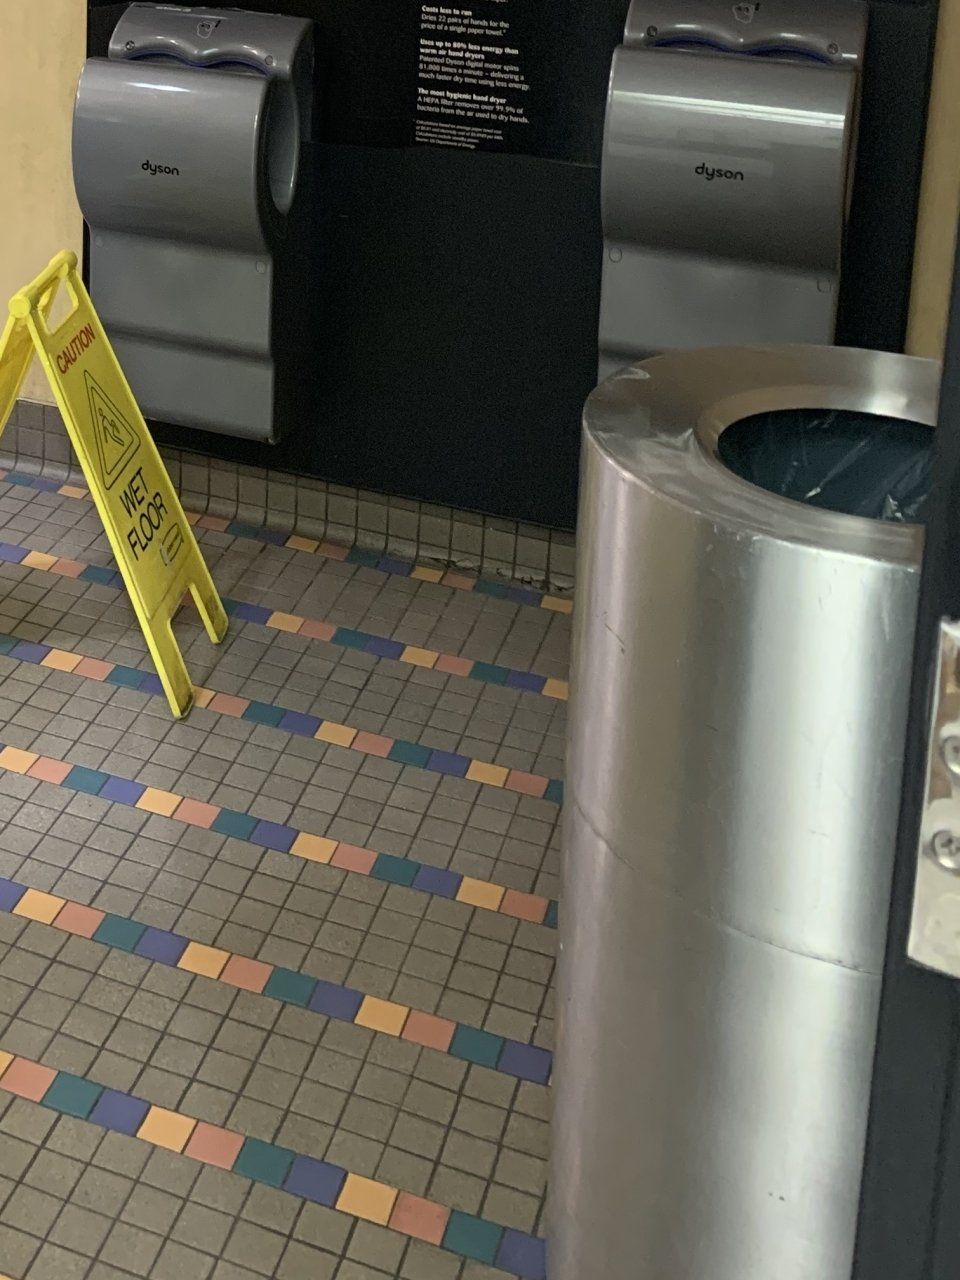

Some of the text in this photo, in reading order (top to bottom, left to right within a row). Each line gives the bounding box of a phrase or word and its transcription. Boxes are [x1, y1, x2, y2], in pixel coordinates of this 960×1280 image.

[421, 5, 439, 13] Costs
[440, 6, 452, 14] less
[420, 38, 435, 46] Uses
[468, 43, 481, 51] less
[481, 46, 503, 55] energy
[504, 47, 519, 55] than
[448, 49, 464, 57] hand
[464, 51, 485, 60] dryers
[418, 87, 429, 95] The
[446, 90, 472, 100] hygienic
[472, 93, 489, 102] hand
[489, 96, 507, 105] dryer
[141, 159, 180, 176] dyson
[694, 162, 744, 181] dyson
[57, 323, 96, 375] CAUTION
[119, 467, 149, 518] WET
[126, 492, 169, 561] FLOOR
